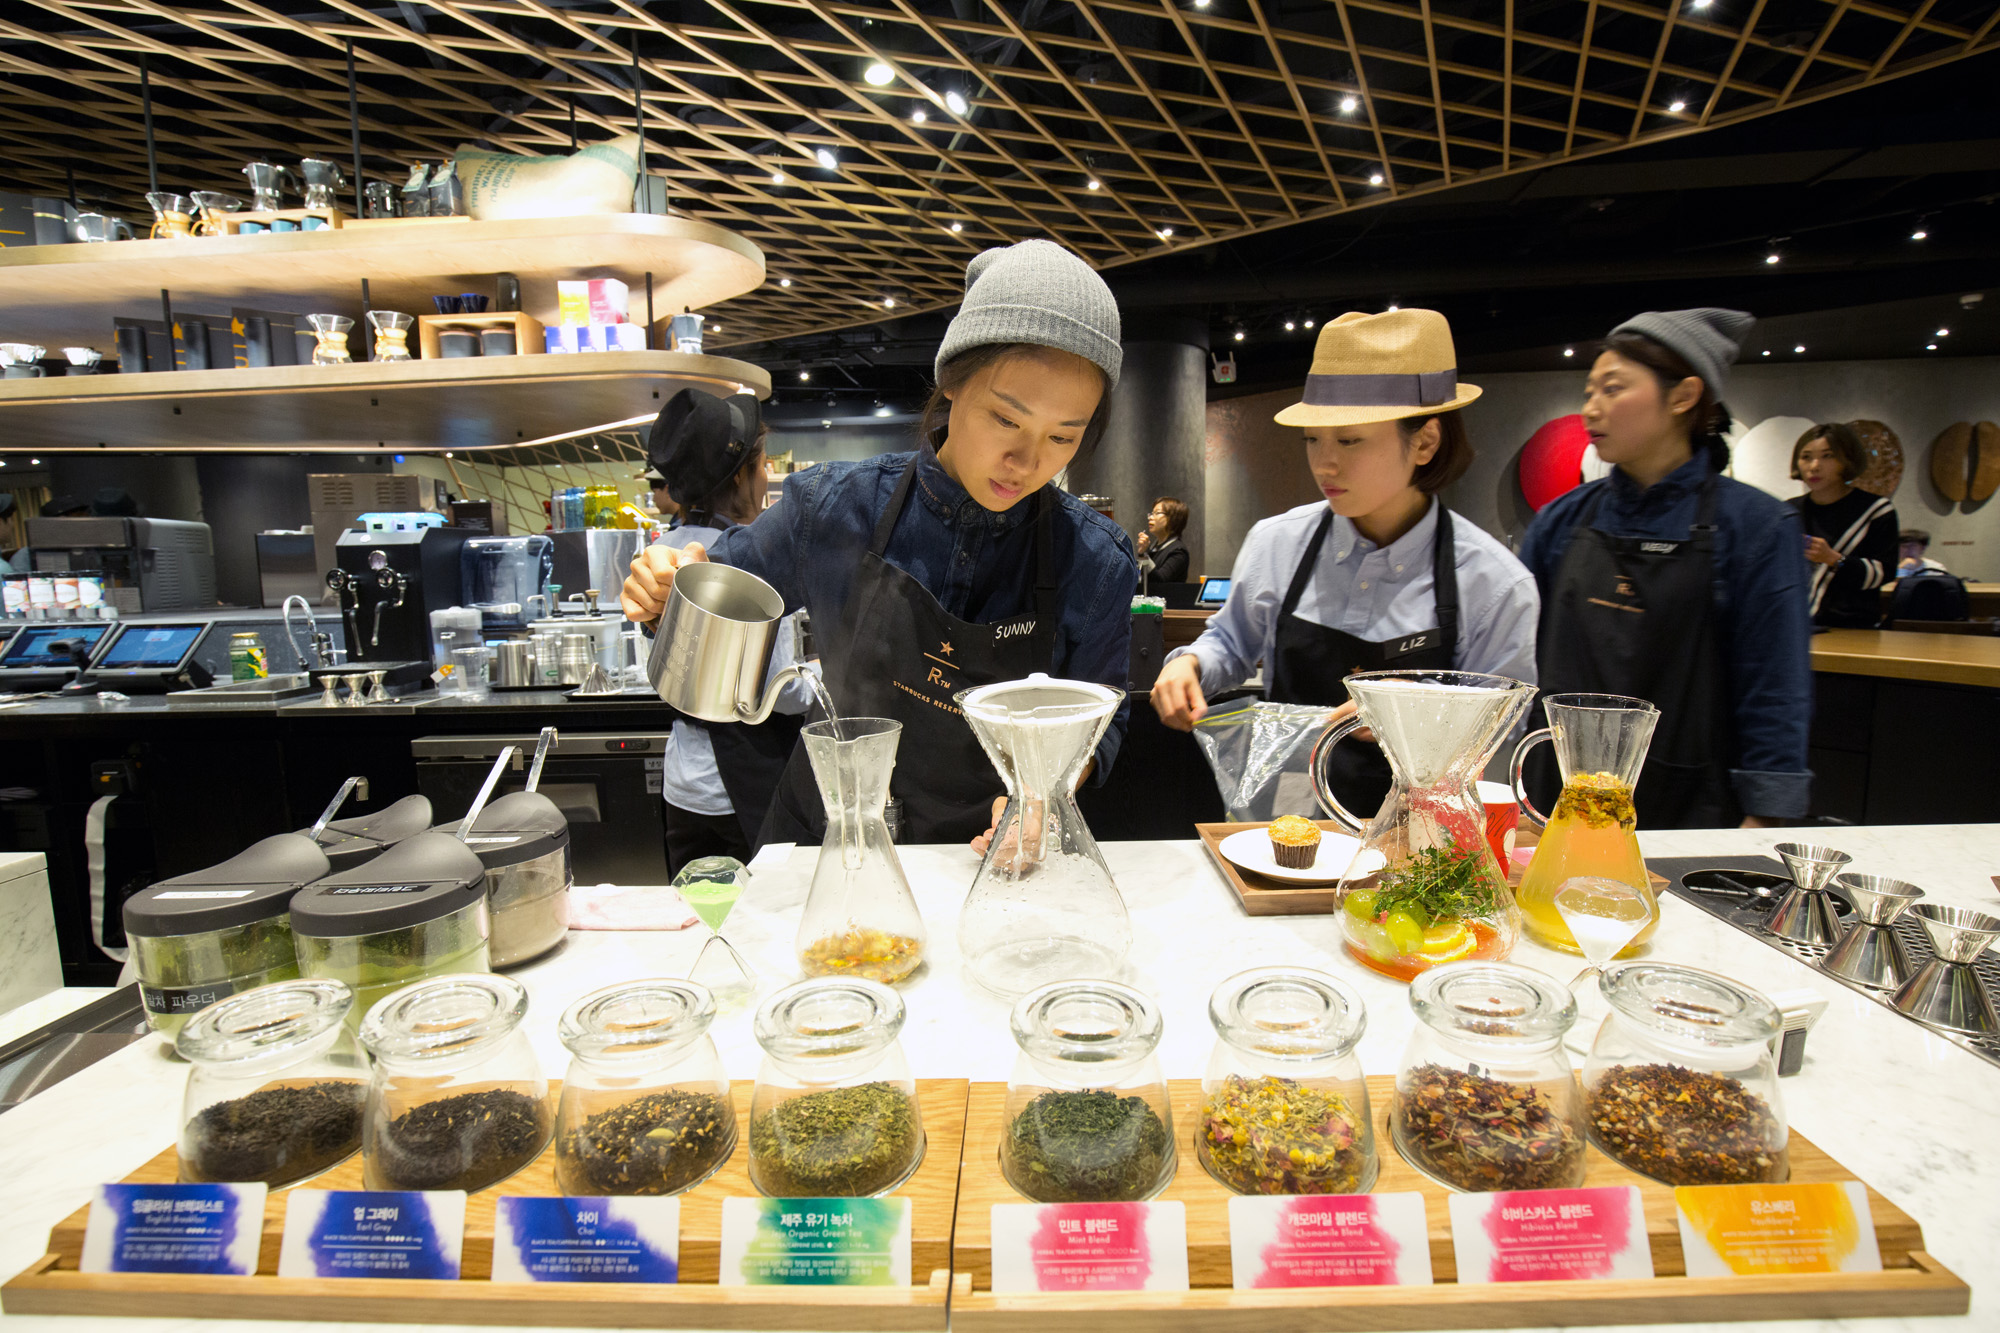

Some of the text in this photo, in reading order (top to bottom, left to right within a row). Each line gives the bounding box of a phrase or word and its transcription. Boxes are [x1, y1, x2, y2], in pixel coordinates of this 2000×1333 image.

[995, 621, 1036, 639] SUNNY
[1400, 636, 1427, 651] LIZ
[893, 680, 962, 715] STARBUCKS RESERV
[172, 991, 216, 1008] 파우더
[353, 1207, 399, 1221] 얼 그레이
[1501, 1205, 1594, 1222] 히비스커스 블렌드
[1751, 1200, 1796, 1215] 유스베리
[576, 1211, 599, 1225] 차이
[780, 1213, 854, 1227] 제주 유기 녹차
[1288, 1211, 1369, 1226] 캐모마일 블렌드
[356, 1222, 372, 1231] Earl
[577, 1227, 596, 1235] Chai
[1058, 1219, 1119, 1233] 민트 블렌드
[1295, 1227, 1363, 1237] Chamomile Blend
[1520, 1221, 1578, 1231] Hibiscus Blend
[771, 1229, 862, 1239] Jeju Organic Green Tea
[1088, 1235, 1110, 1243] Blend
